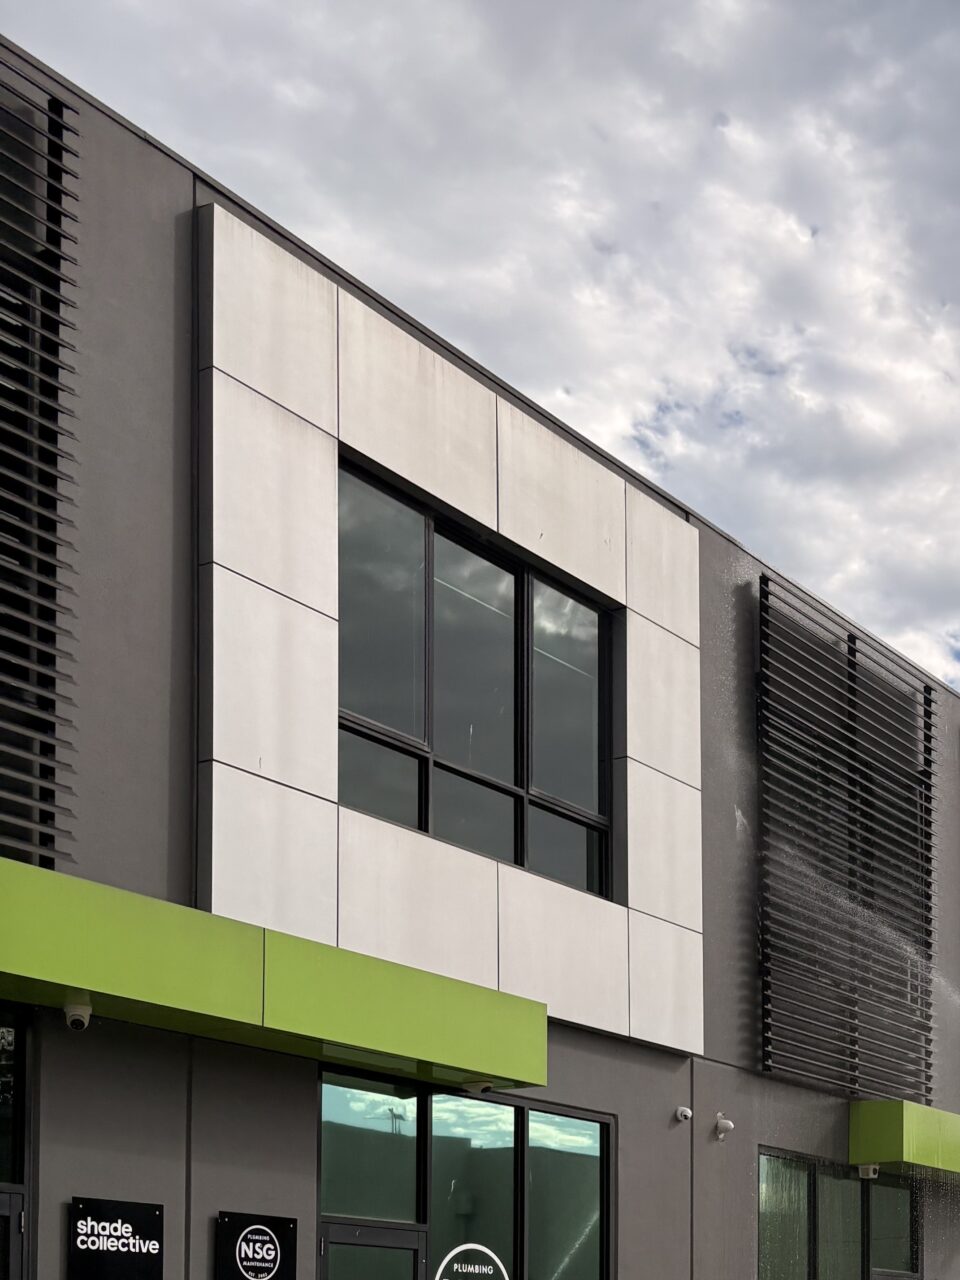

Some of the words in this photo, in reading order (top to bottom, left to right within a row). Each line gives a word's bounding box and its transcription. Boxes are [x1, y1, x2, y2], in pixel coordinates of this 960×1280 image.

[77, 1216, 133, 1237] shade
[77, 1235, 160, 1254] collective
[241, 1241, 276, 1260] NSG
[453, 1263, 494, 1275] PLUMBING
